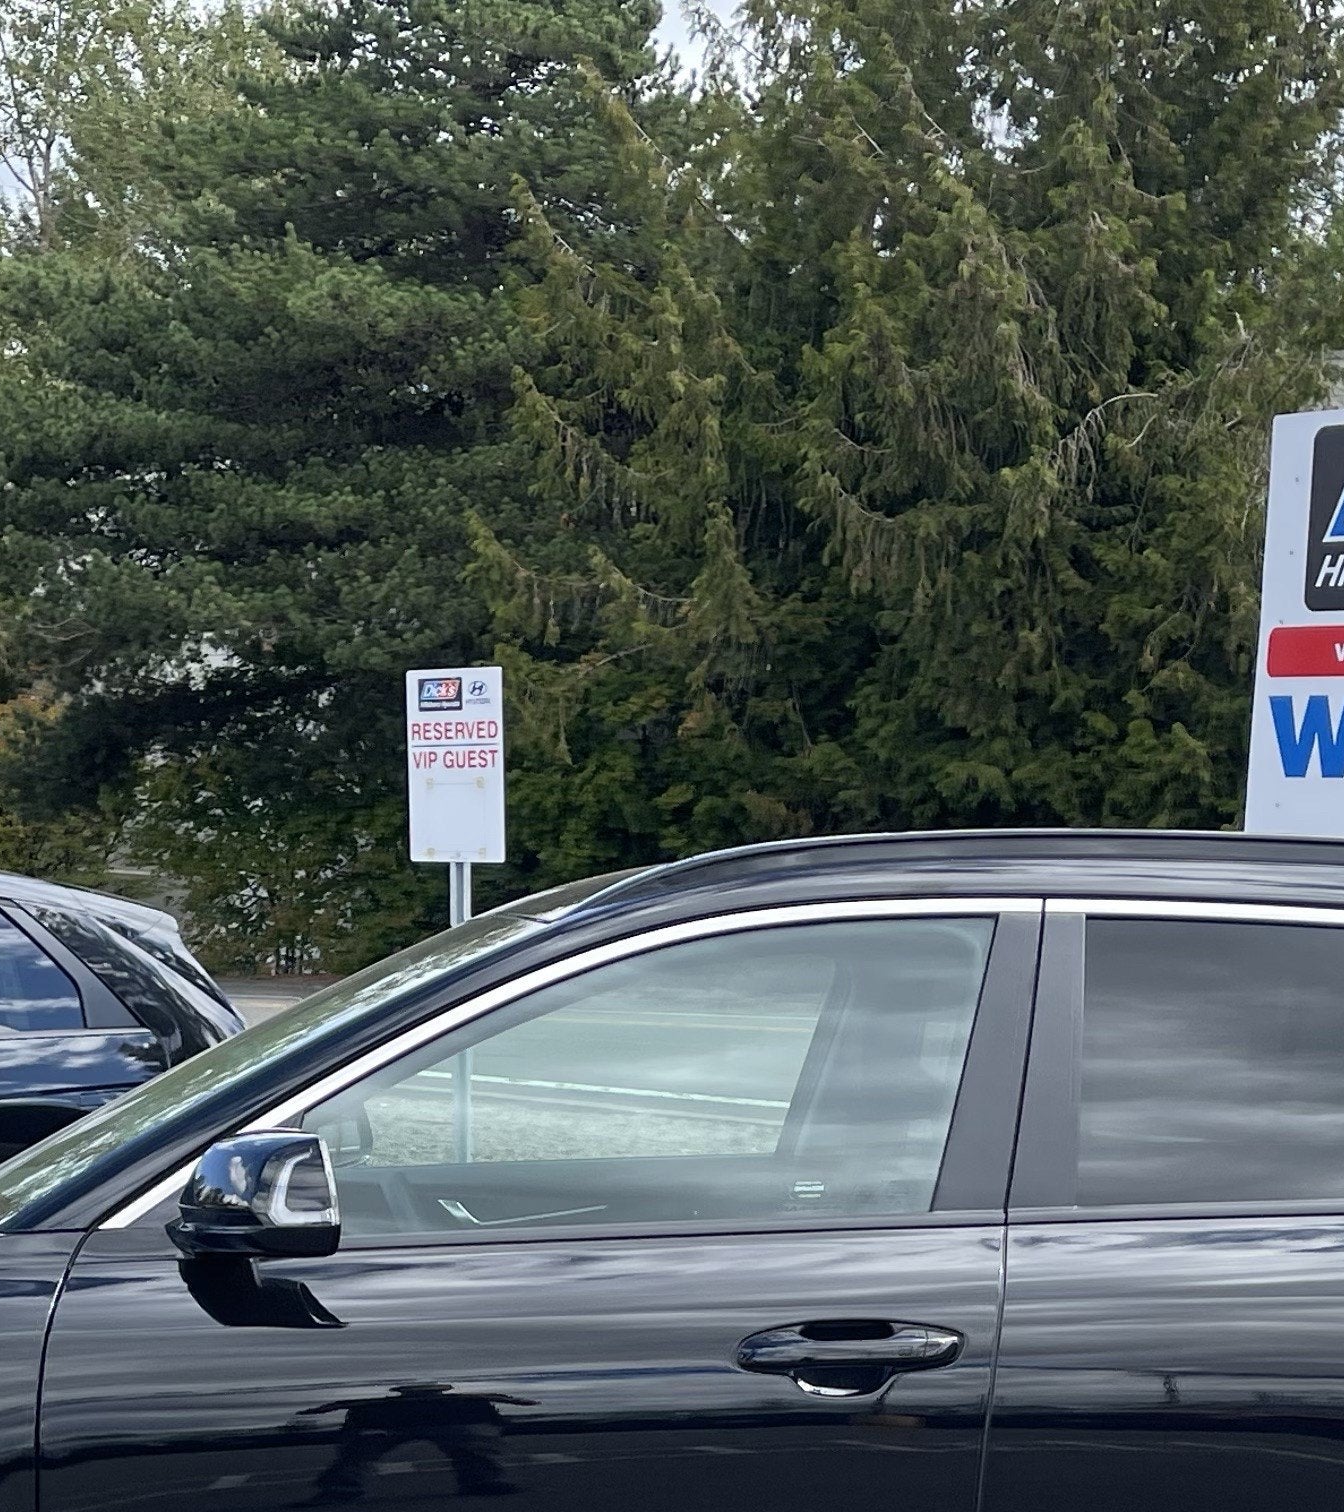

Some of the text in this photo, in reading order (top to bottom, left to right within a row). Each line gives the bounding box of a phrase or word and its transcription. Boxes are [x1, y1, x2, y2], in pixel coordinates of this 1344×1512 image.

[411, 721, 498, 740] RESERVED
[412, 750, 498, 769] VIP GUEST
